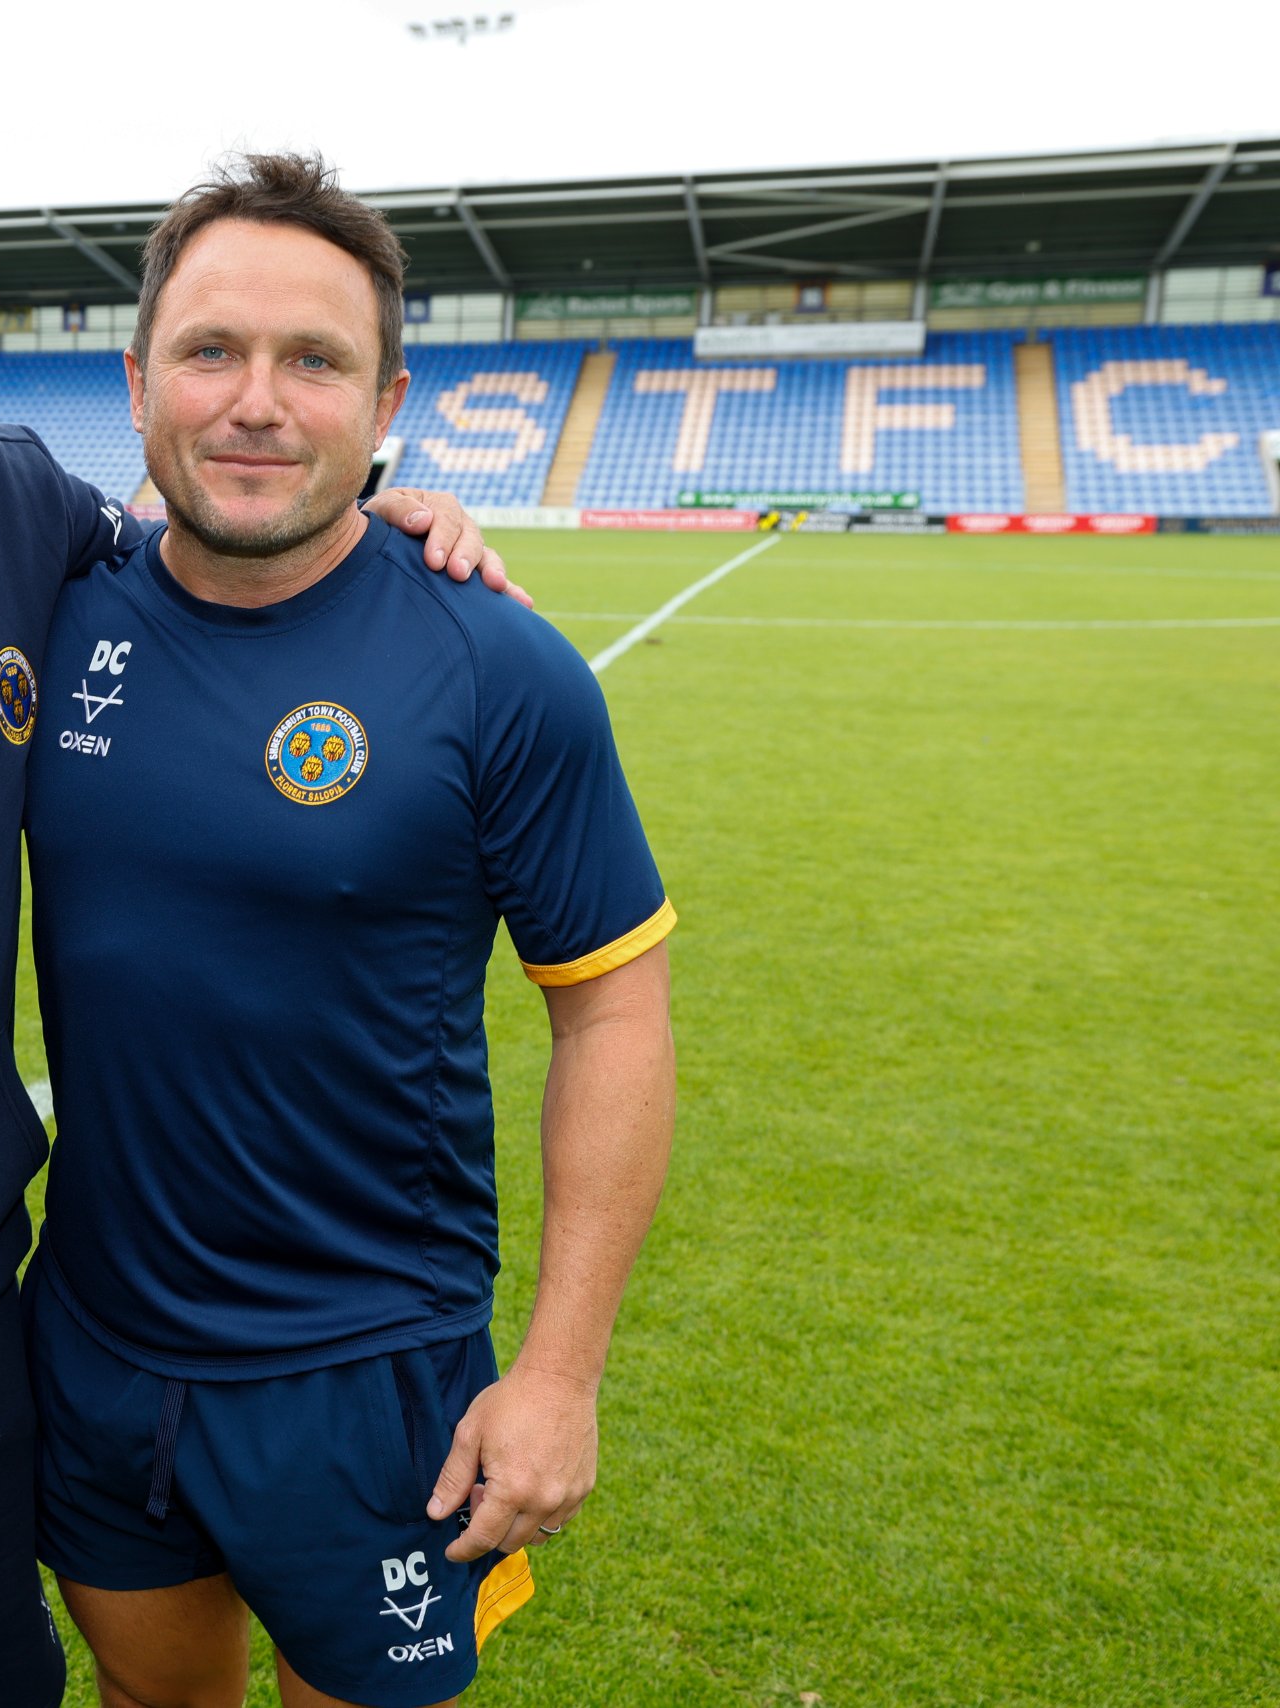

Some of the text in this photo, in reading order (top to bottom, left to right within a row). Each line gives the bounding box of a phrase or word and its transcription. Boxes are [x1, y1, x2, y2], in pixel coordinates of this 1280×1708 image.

[88, 639, 133, 676] DC
[58, 730, 112, 757] OXEN
[269, 705, 366, 774] SHREWSBURY TOWN FOOTBALL CLUB
[275, 775, 345, 802] FLOREAT SALOPIA
[381, 1551, 429, 1592] DC
[387, 1632, 455, 1663] OXEN
